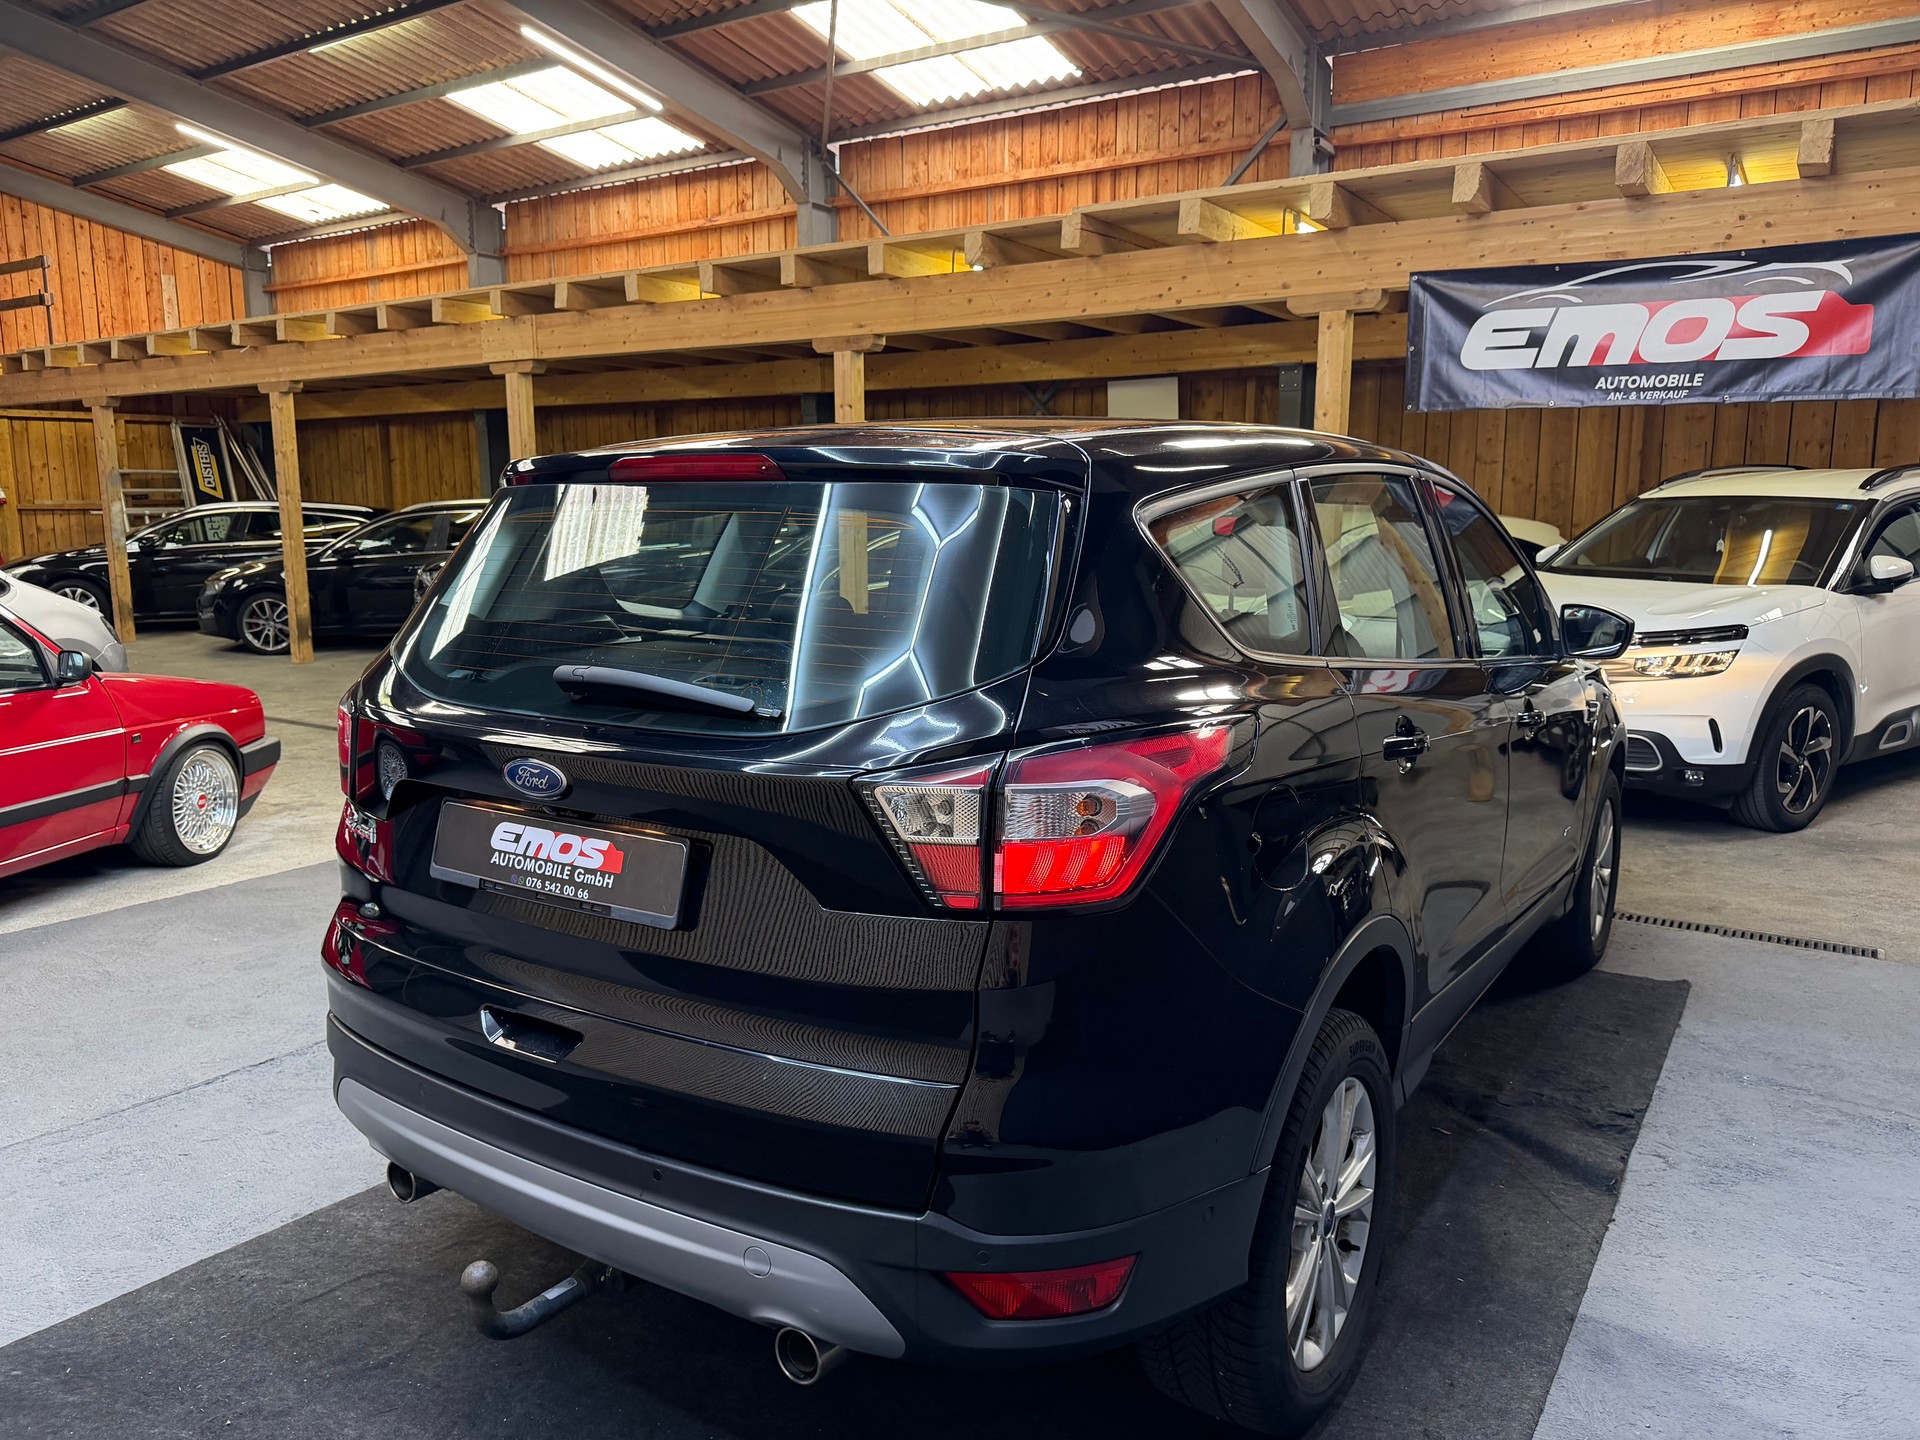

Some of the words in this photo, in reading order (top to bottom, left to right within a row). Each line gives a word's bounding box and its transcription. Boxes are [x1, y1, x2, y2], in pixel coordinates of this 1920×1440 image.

[1460, 290, 1828, 370] EMOS
[1595, 373, 1704, 389] AUTOMOBILE
[1607, 391, 1627, 400] AN-
[1628, 391, 1638, 400] &
[1639, 389, 1689, 400] VERKAUF
[197, 444, 215, 487] CUSTERS
[515, 765, 549, 789] Ford
[490, 822, 610, 868] EMOS
[490, 851, 571, 879] AUTOMOBILE
[574, 868, 614, 888] GmbH
[526, 876, 542, 890] 076
[544, 880, 561, 894] 542
[563, 885, 575, 896] 00
[577, 887, 589, 899] 66
